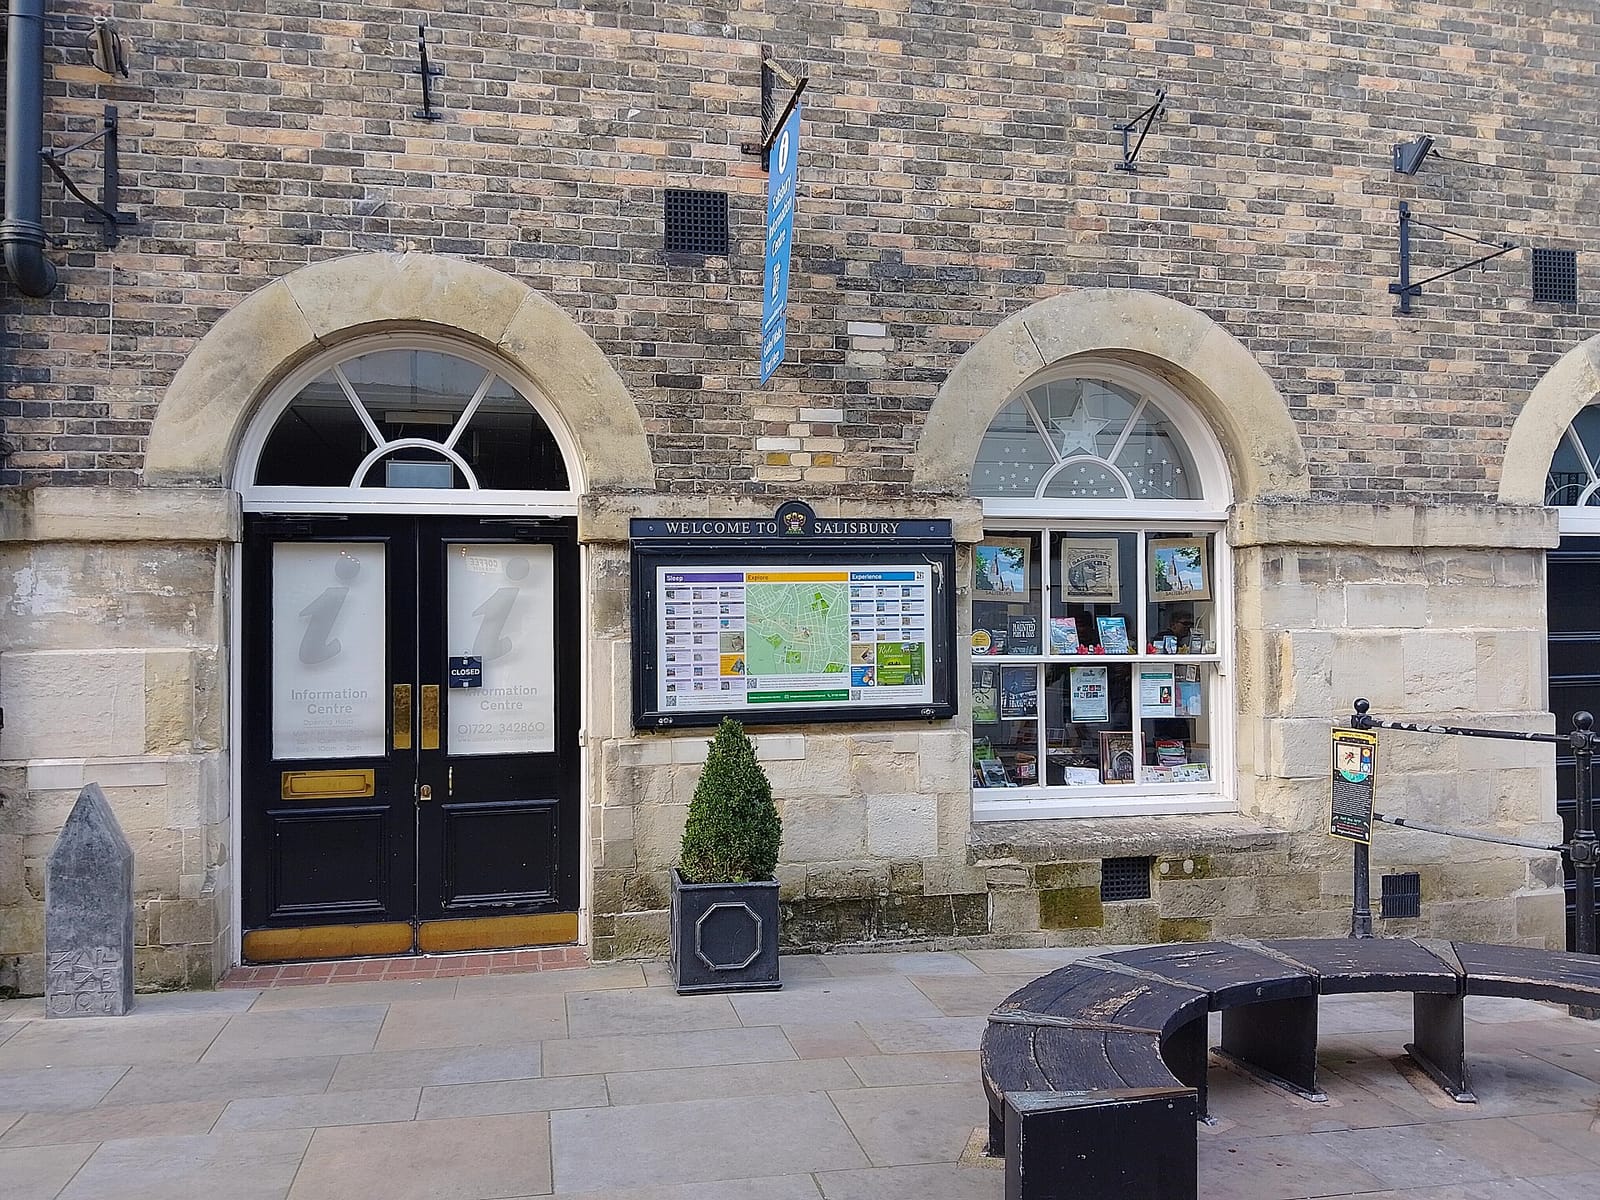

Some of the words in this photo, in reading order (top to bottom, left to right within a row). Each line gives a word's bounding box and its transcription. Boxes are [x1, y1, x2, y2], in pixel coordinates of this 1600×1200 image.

[772, 173, 792, 212] Salisbury
[768, 195, 793, 240] Information
[771, 228, 786, 257] Centre
[665, 521, 751, 534] WELCOME
[756, 521, 777, 534] TO
[814, 521, 900, 535] SALISBURY
[747, 575, 769, 583] Explore
[852, 573, 882, 581] Experience
[291, 688, 368, 700] Information
[307, 703, 353, 714] Centre
[480, 700, 523, 711] Centre
[457, 723, 493, 735] 01722
[498, 721, 546, 733] 342860
